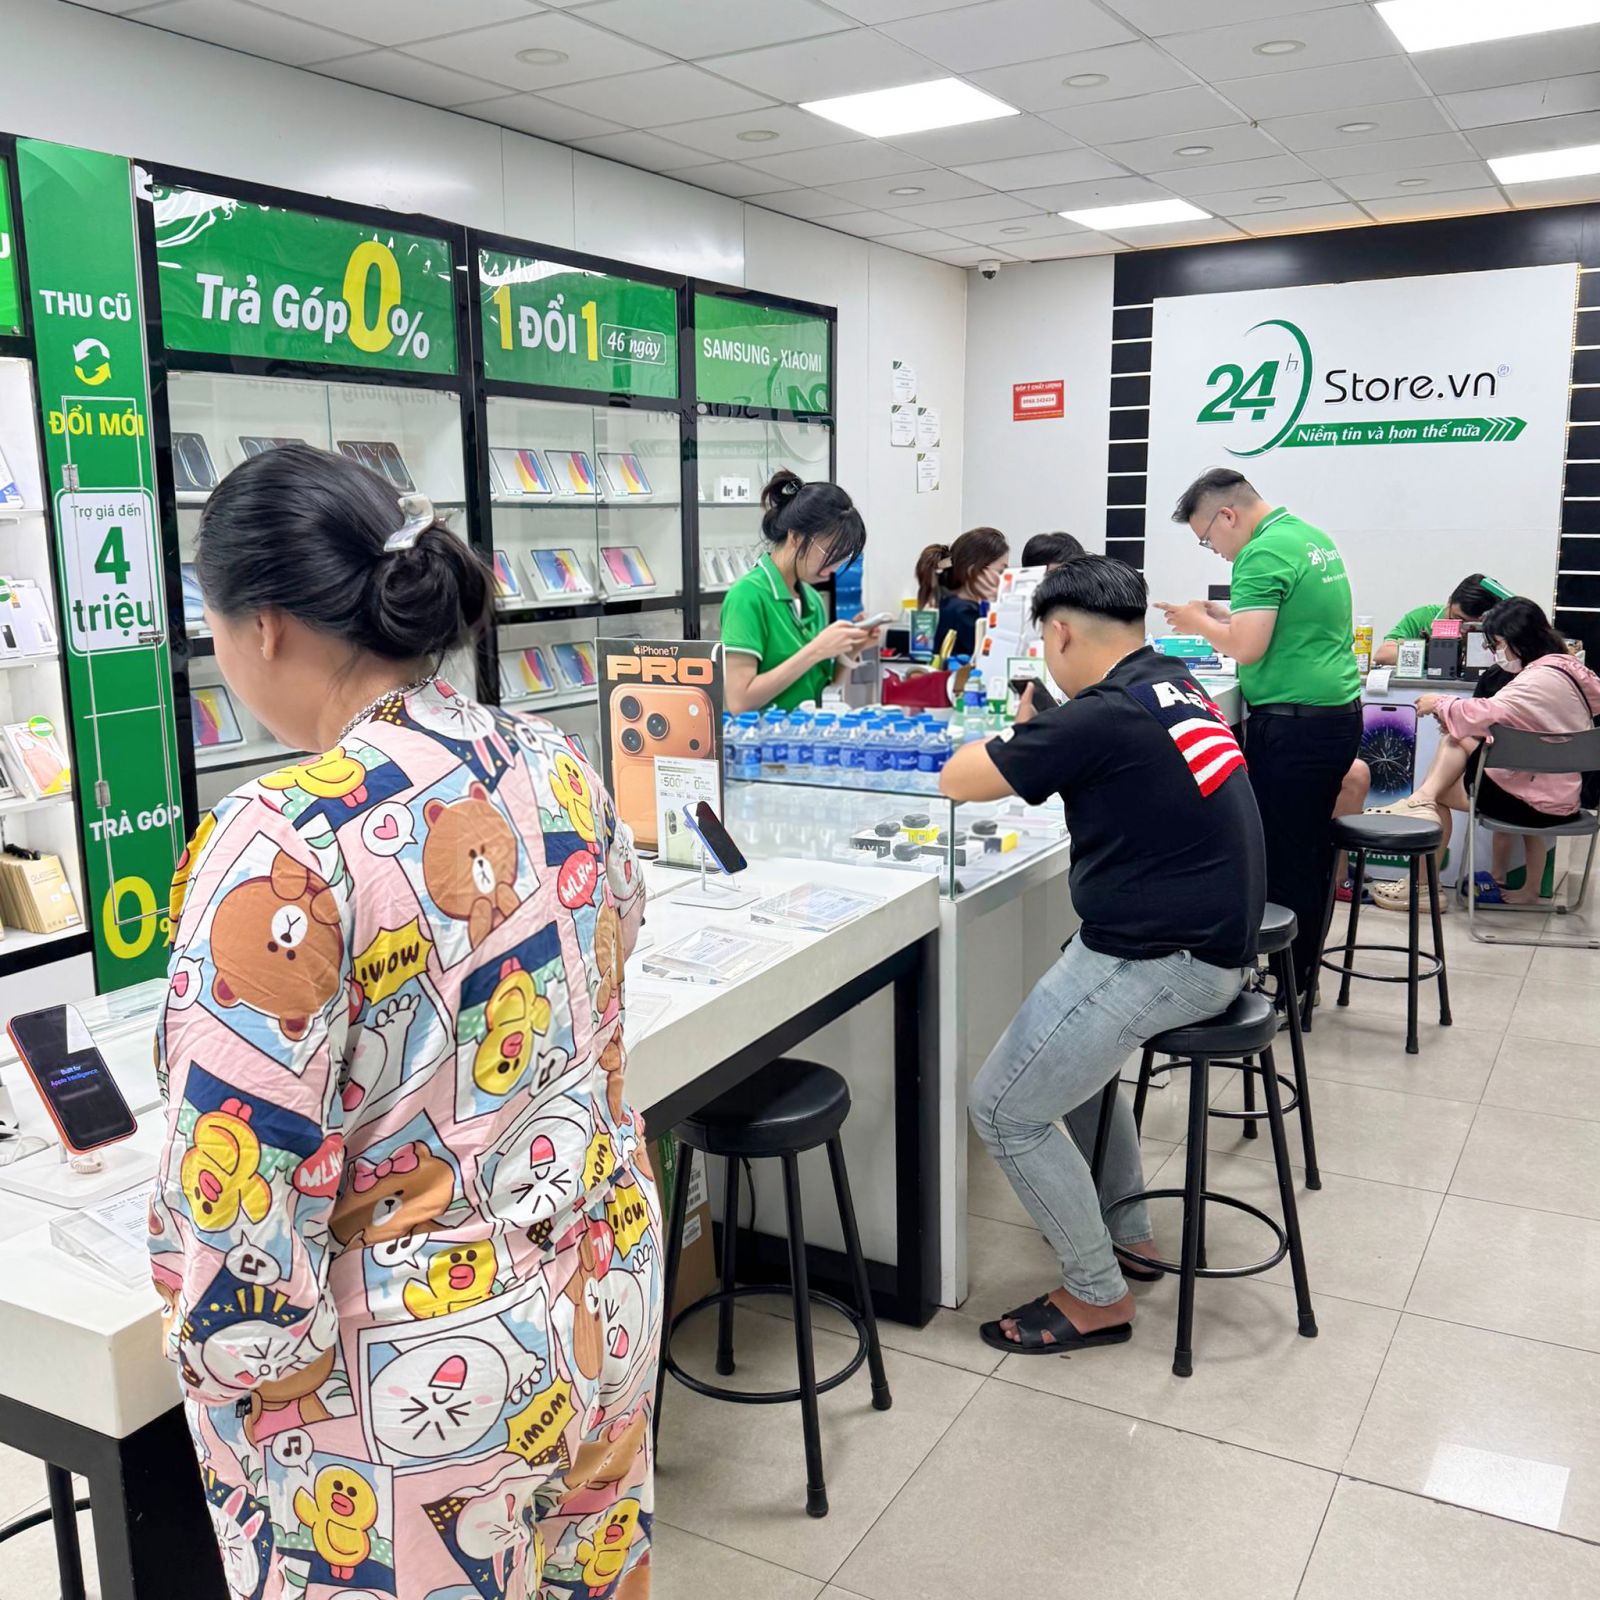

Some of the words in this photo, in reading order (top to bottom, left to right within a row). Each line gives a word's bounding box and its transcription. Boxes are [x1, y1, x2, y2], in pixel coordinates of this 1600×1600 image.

[39, 289, 93, 319] THU
[98, 292, 132, 322] CŨ
[196, 272, 262, 325] Trả
[272, 286, 348, 345] Góp
[493, 285, 514, 351] 1
[518, 293, 577, 354] ĐỔI
[581, 300, 599, 362] 1
[607, 330, 626, 353] 46
[629, 336, 661, 361] ngày
[703, 337, 770, 366] SAMSUNG
[780, 348, 822, 372] XIAOMI
[49, 404, 93, 437] ĐỔI
[99, 407, 145, 437] MỚI
[1297, 425, 1337, 442] Niềm
[1342, 426, 1362, 441] tin
[1367, 426, 1384, 440] và
[1388, 425, 1417, 440] hơn
[1422, 421, 1452, 438] thế
[1452, 423, 1480, 438] nữa
[96, 503, 115, 520] giá
[118, 502, 142, 517] đến
[94, 526, 131, 585] 4
[73, 592, 155, 637] triệu
[640, 645, 669, 656] iPhone
[670, 646, 679, 656] 17
[606, 654, 714, 685] PRO
[89, 809, 134, 842] TRẢ
[137, 803, 182, 832] GÓP
